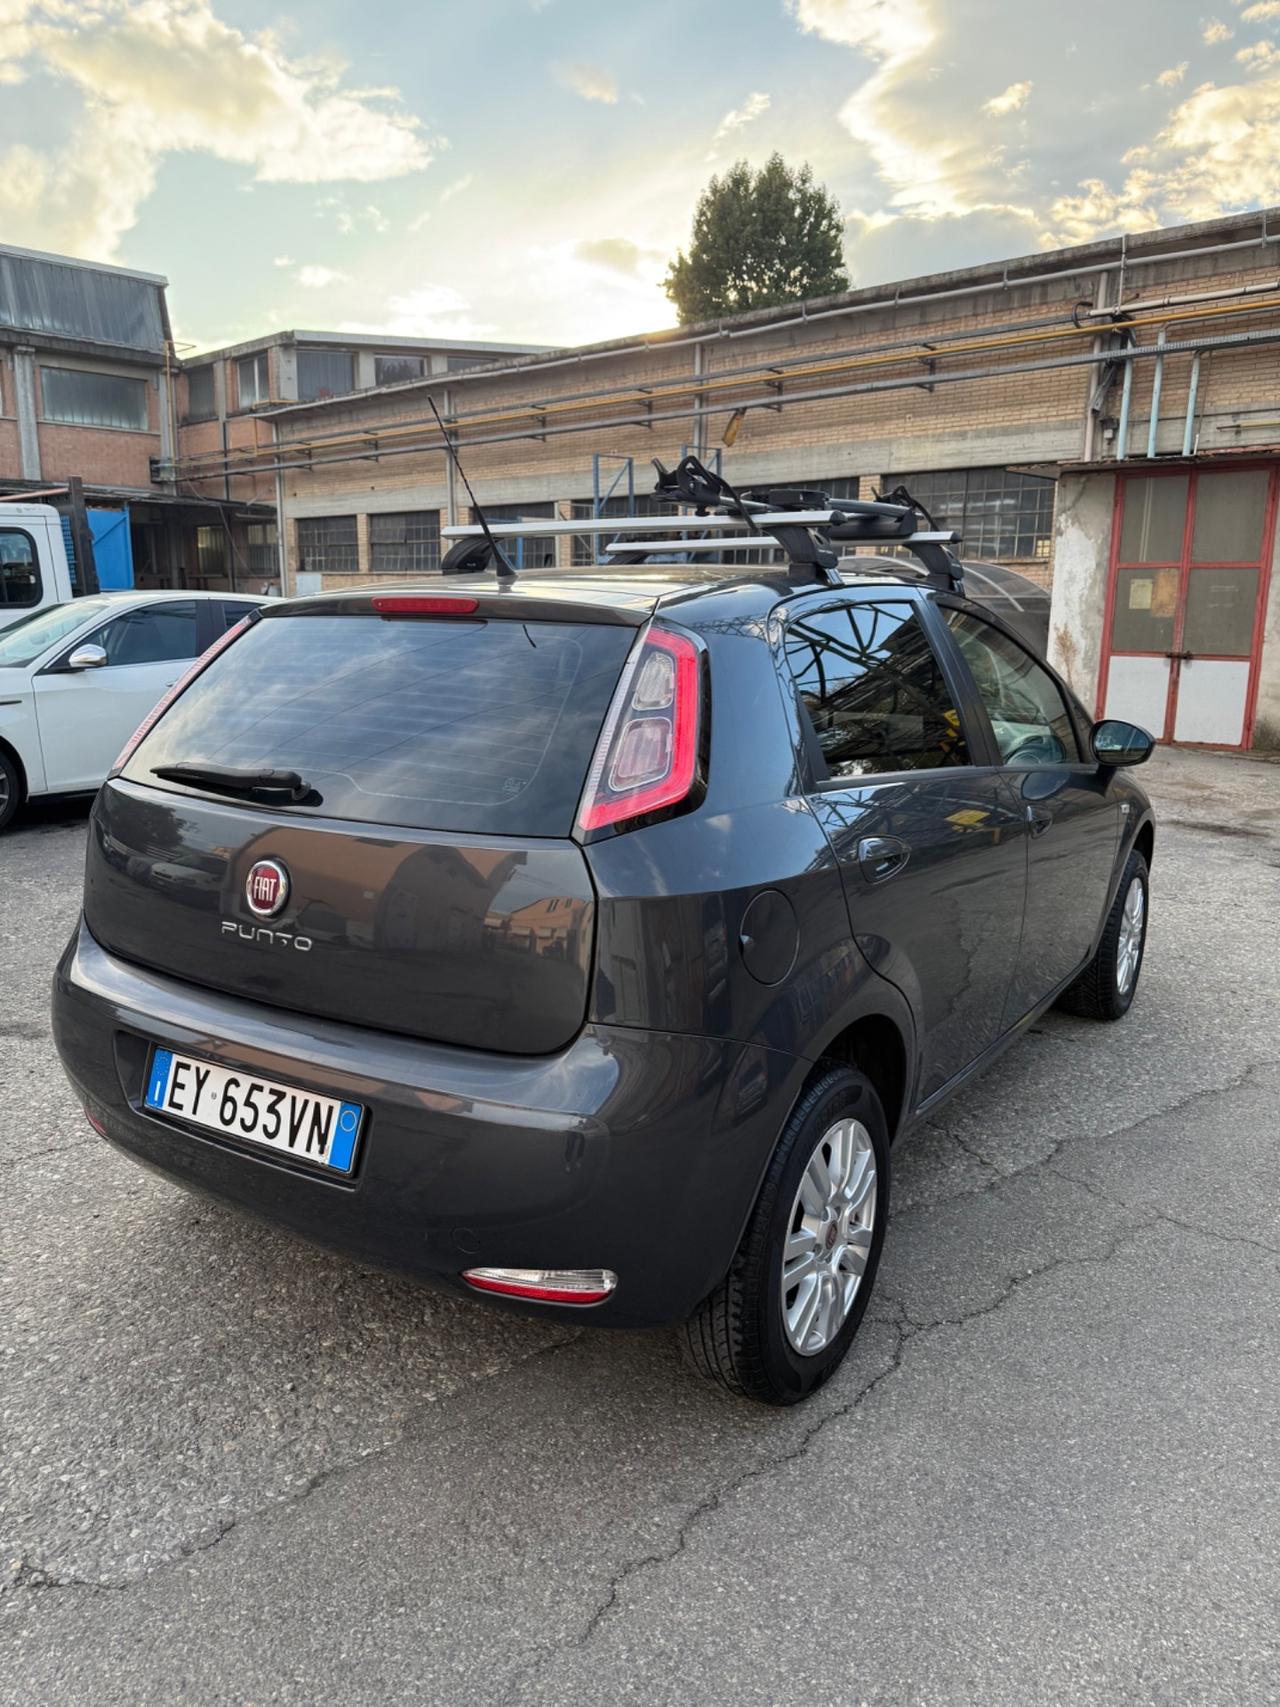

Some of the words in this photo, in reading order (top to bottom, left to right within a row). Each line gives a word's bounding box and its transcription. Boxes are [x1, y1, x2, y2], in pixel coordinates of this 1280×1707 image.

[253, 876, 277, 901] FIAT
[221, 921, 313, 951] PUNTO
[168, 1061, 211, 1115] EY
[219, 1077, 334, 1154] 653VN
